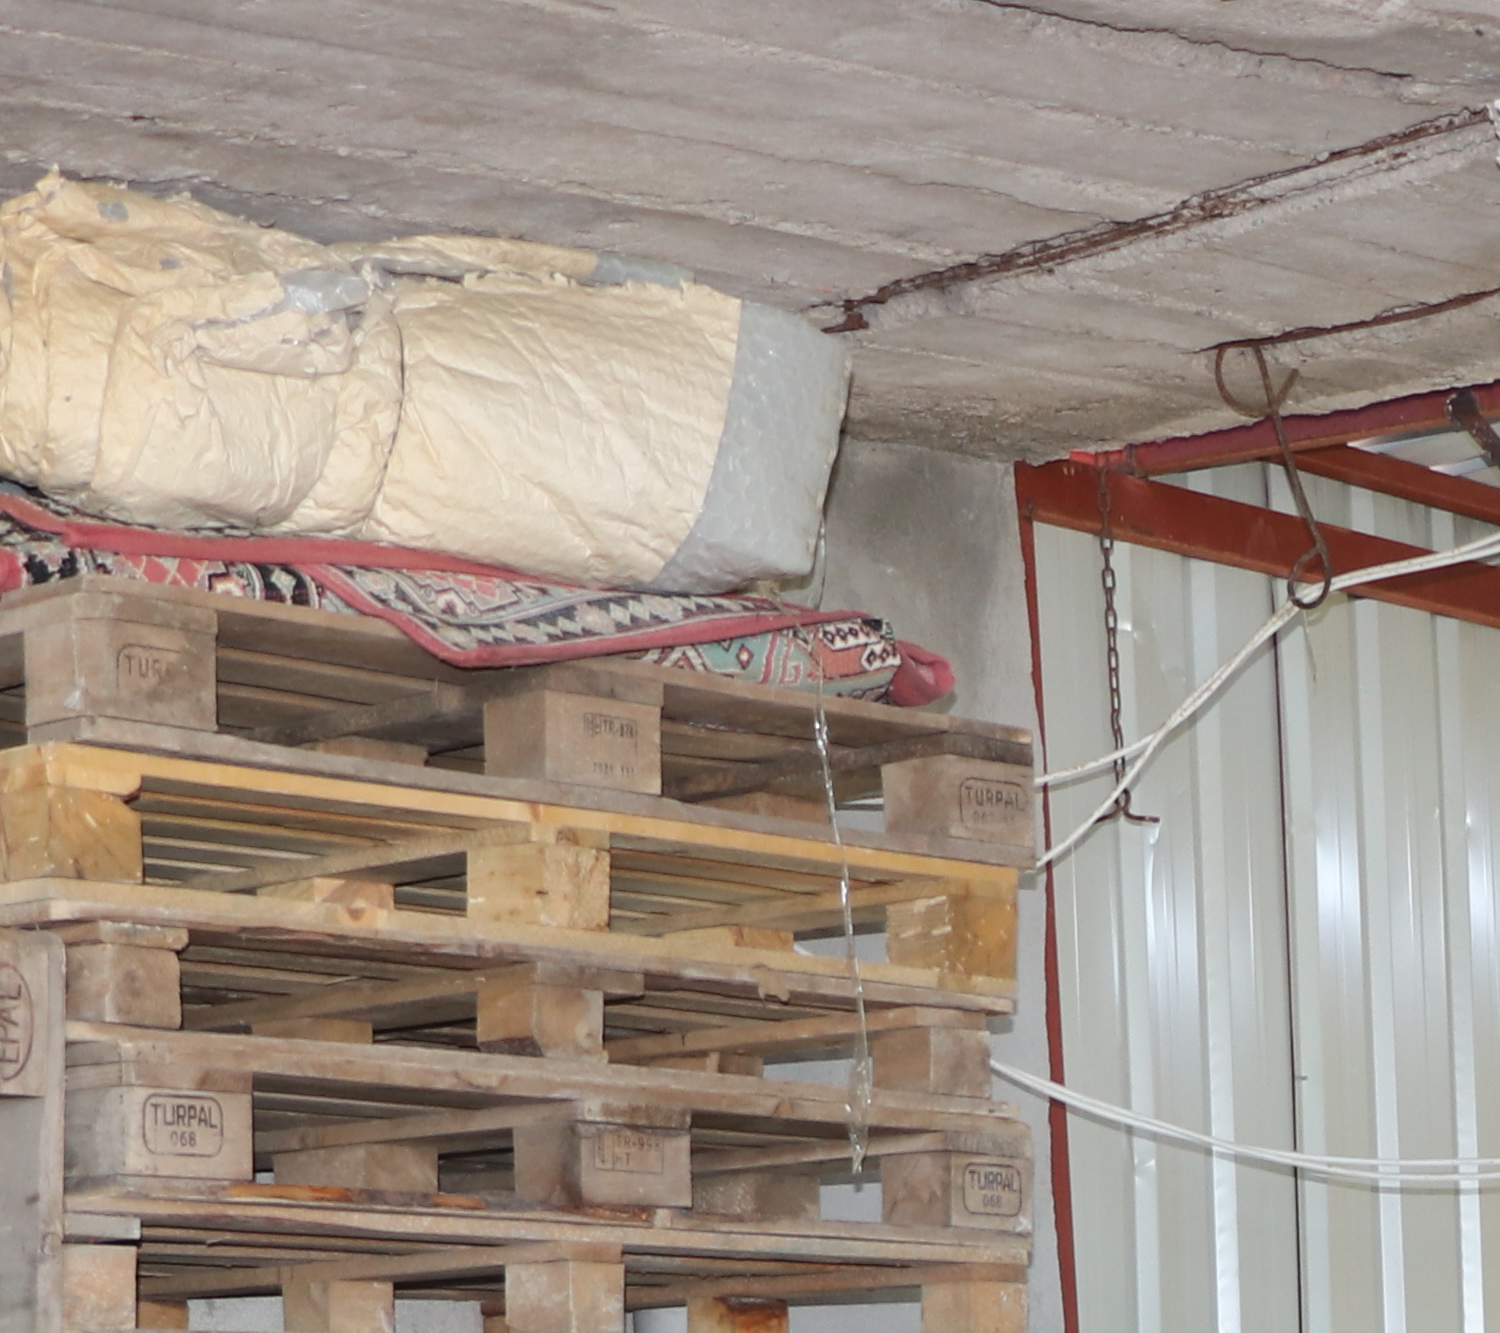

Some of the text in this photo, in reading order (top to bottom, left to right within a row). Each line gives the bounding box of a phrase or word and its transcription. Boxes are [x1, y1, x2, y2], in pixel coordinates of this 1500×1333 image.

[965, 785, 1025, 811] TURPAL
[150, 1103, 218, 1128] TURPAL
[969, 1170, 1019, 1192] TURPAL
